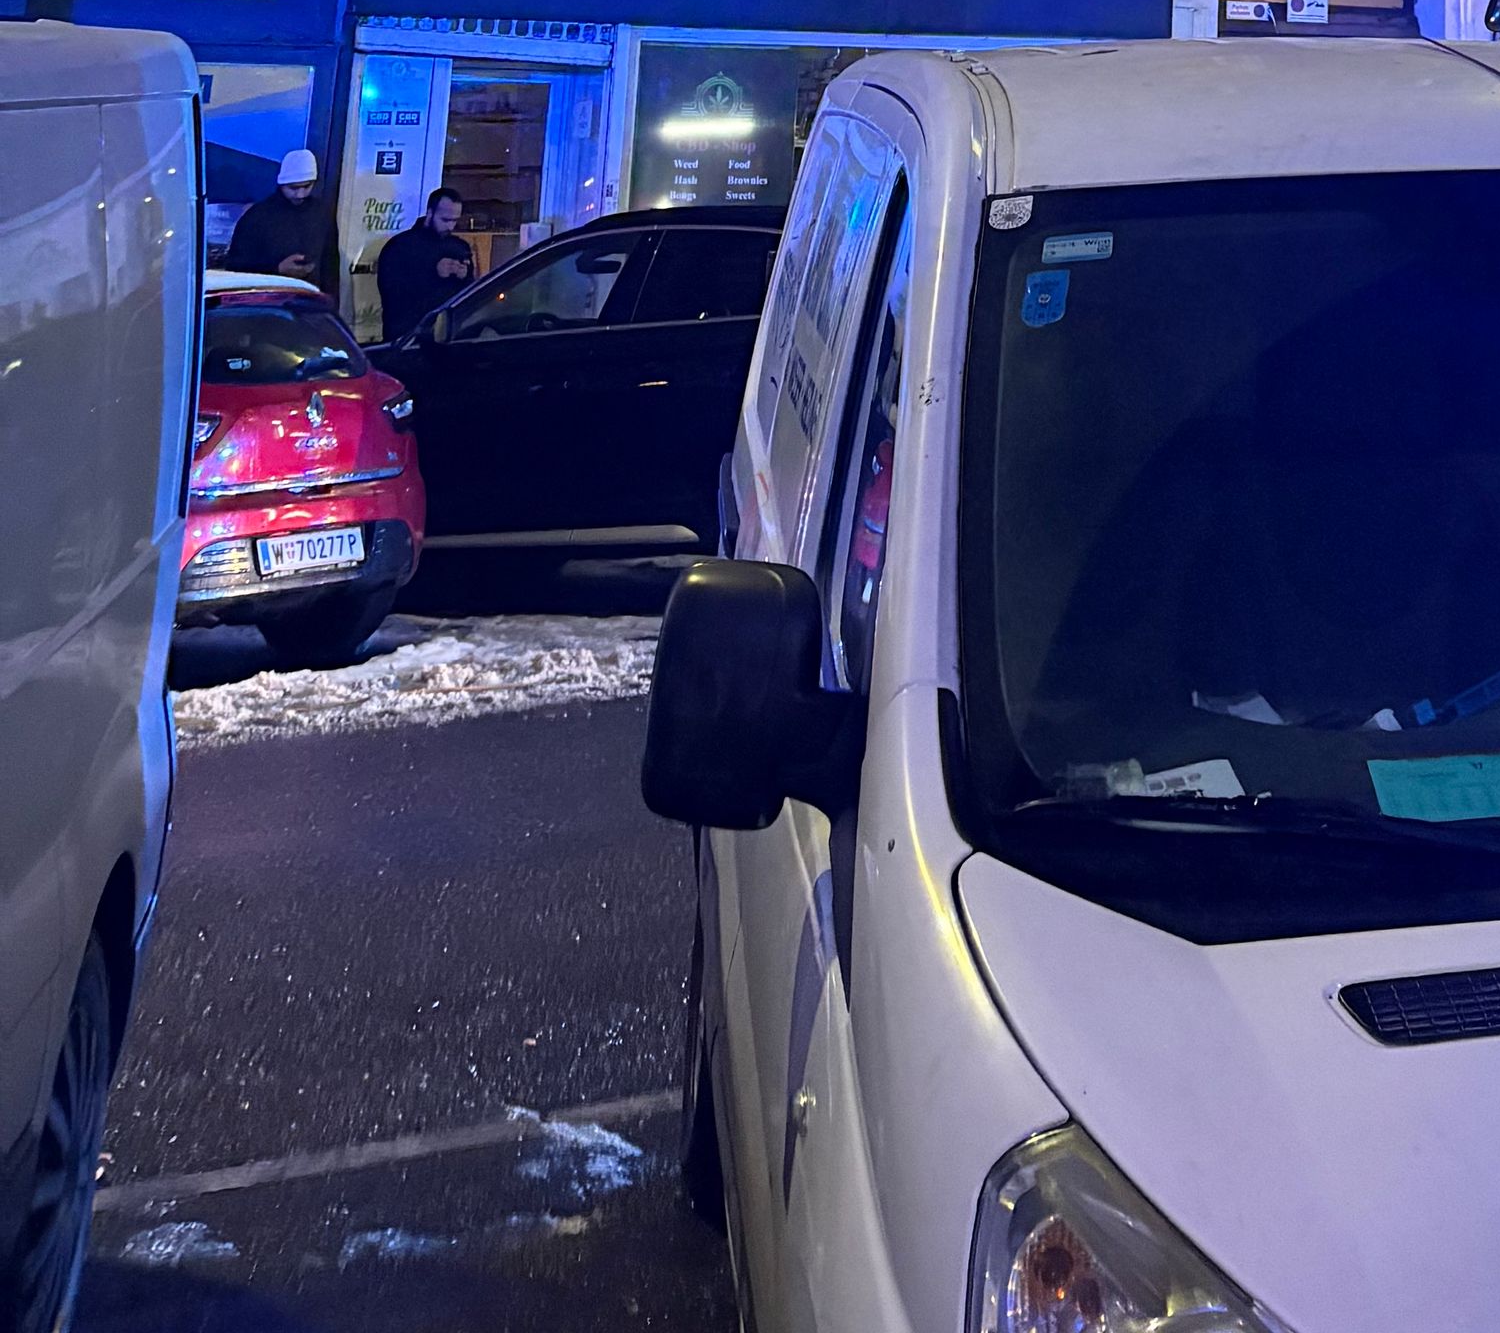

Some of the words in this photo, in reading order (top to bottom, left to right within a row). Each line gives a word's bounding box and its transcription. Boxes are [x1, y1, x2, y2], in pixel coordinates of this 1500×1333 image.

[674, 159, 699, 169] Weed
[728, 159, 751, 169] Food
[674, 175, 698, 185] Hash
[727, 175, 768, 185] Brownies
[725, 190, 756, 201] Sweets
